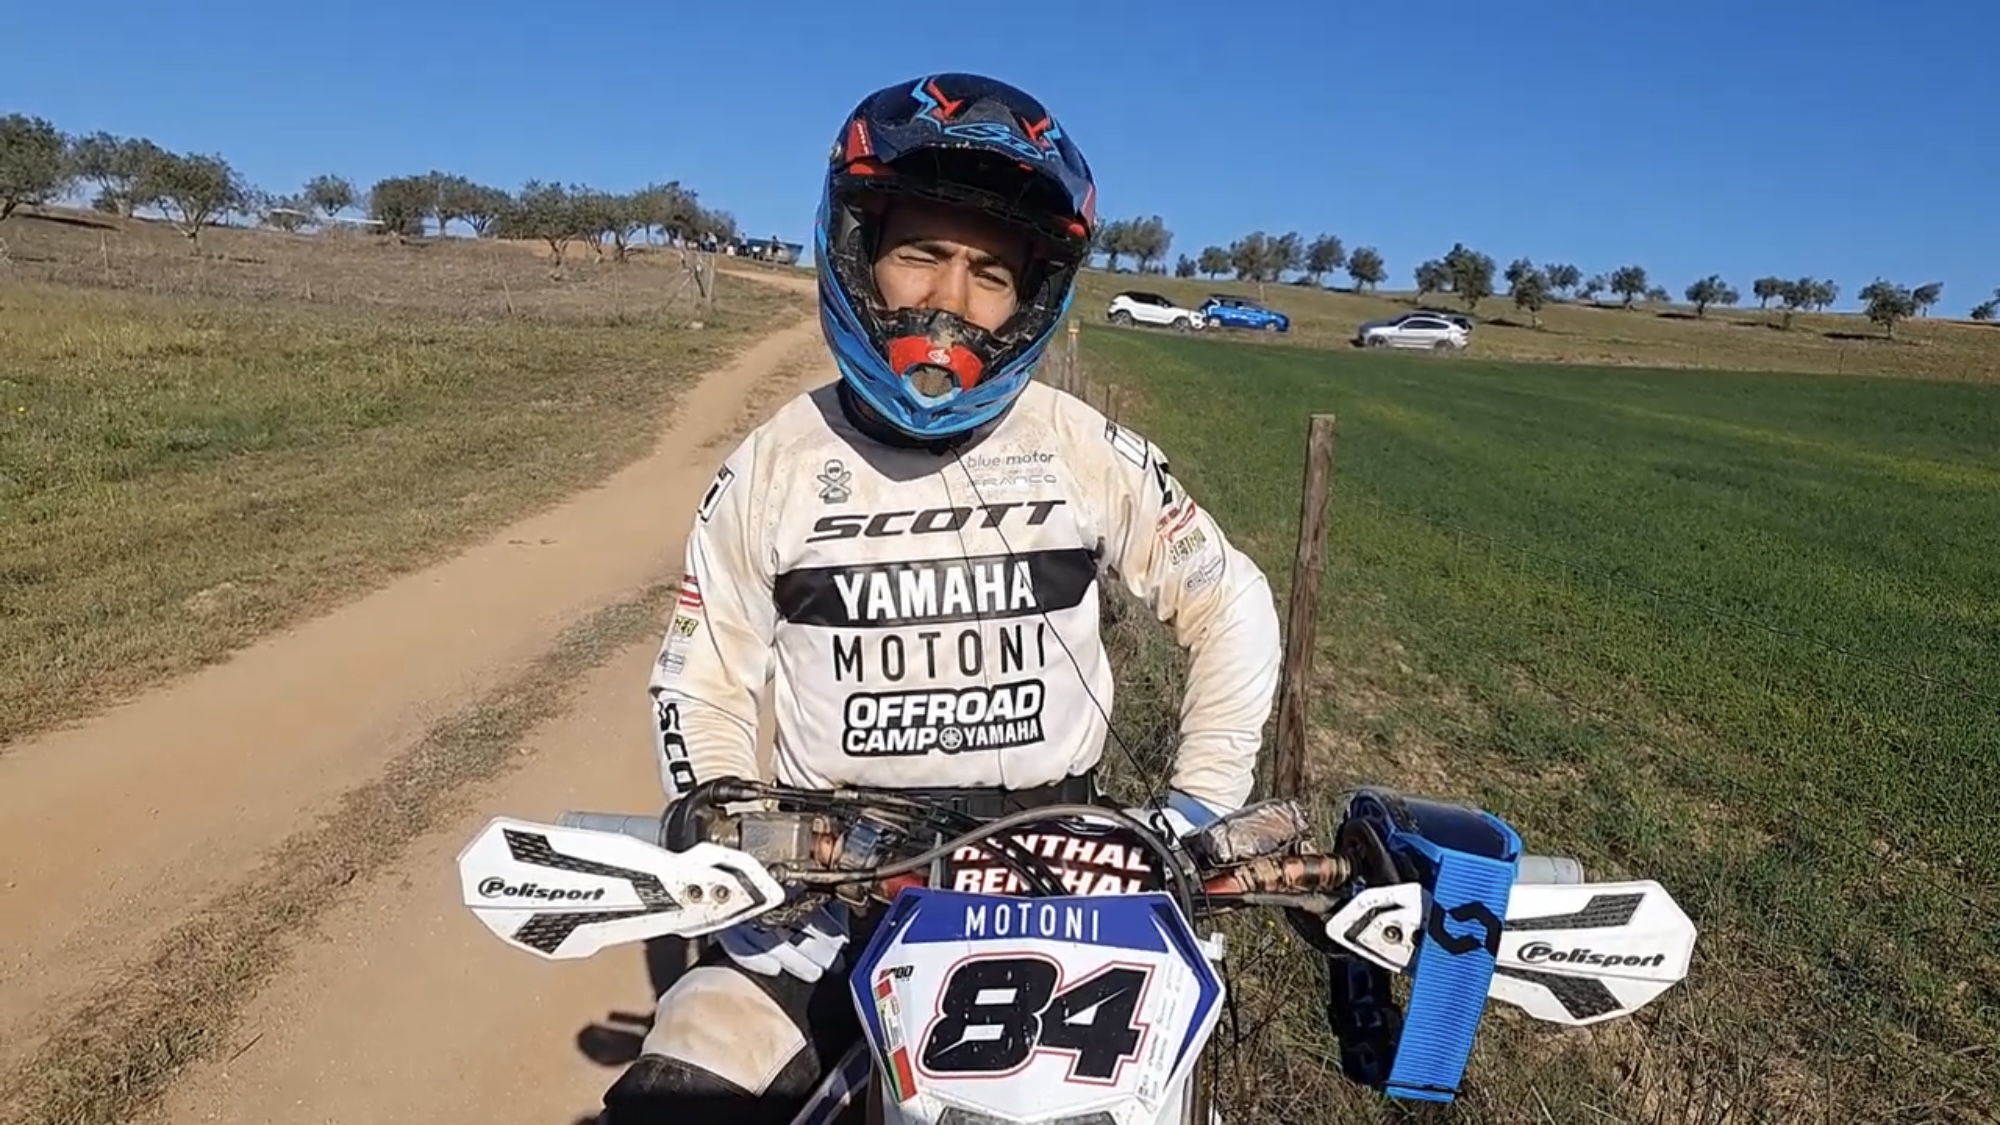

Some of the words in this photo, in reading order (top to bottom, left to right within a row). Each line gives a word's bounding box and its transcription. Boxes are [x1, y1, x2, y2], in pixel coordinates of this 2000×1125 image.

[967, 455, 1001, 468] blue
[1005, 451, 1055, 465] motor
[805, 500, 1067, 543] SCOTT
[833, 560, 1037, 621] YAMAHA
[833, 622, 1045, 682] MOTONI
[848, 683, 1042, 728] OFFROAD
[846, 727, 939, 752] CAMP
[964, 719, 1039, 747] YAMAHA
[478, 876, 606, 901] Polisport
[965, 903, 1099, 941] MOTONI
[1516, 941, 1666, 968] Polisport
[921, 957, 1149, 1080] 84
